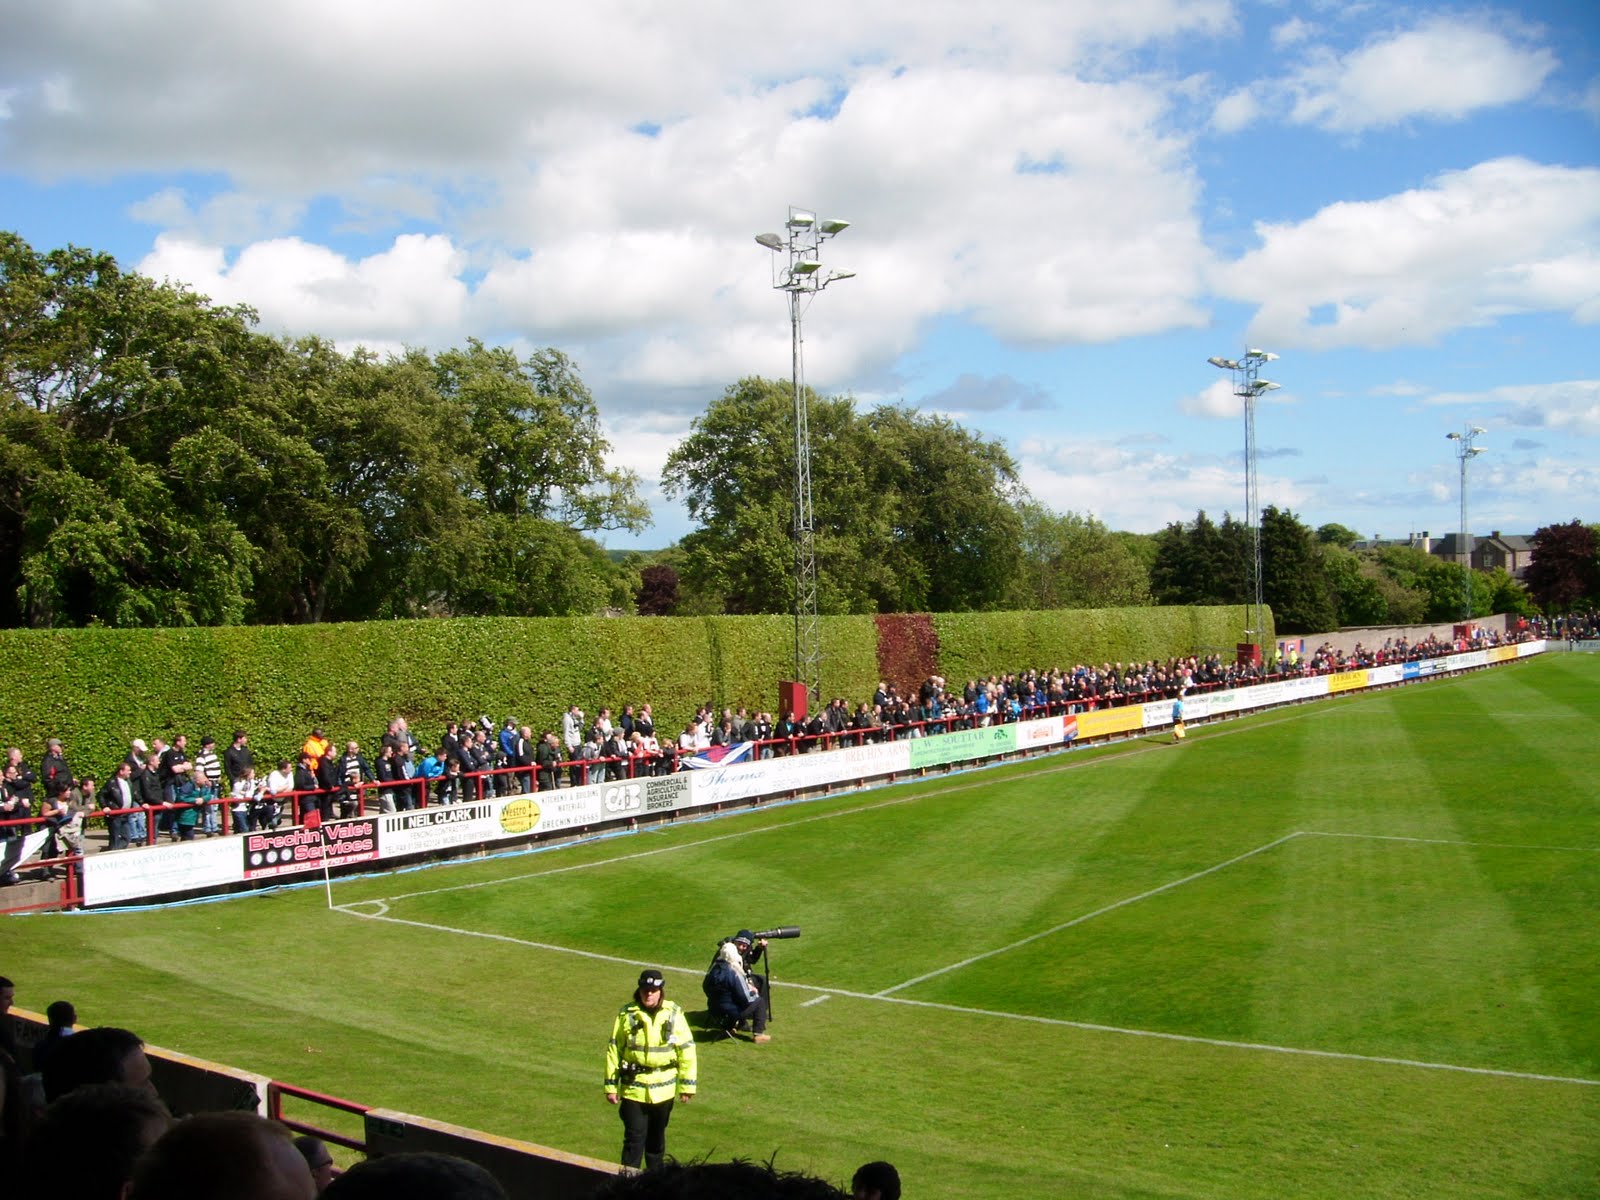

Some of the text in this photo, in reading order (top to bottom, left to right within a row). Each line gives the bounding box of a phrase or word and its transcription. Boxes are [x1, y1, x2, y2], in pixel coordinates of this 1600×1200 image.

[943, 732, 984, 745] SOUTTAR
[845, 746, 883, 761] BRECHIN
[646, 778, 682, 789] COMMERCIAL
[698, 769, 765, 788] Phoenix
[647, 784, 688, 796] AGRICULTURAL
[647, 792, 678, 802] INSURANCE
[558, 801, 586, 811] MATERIALS
[647, 800, 673, 810] BROKERS
[408, 808, 472, 829] NEIL CLARK
[542, 818, 571, 829] BRECHIN
[249, 822, 373, 852] Brechin Valet
[294, 838, 373, 860] Services
[88, 860, 129, 873] JAMES
